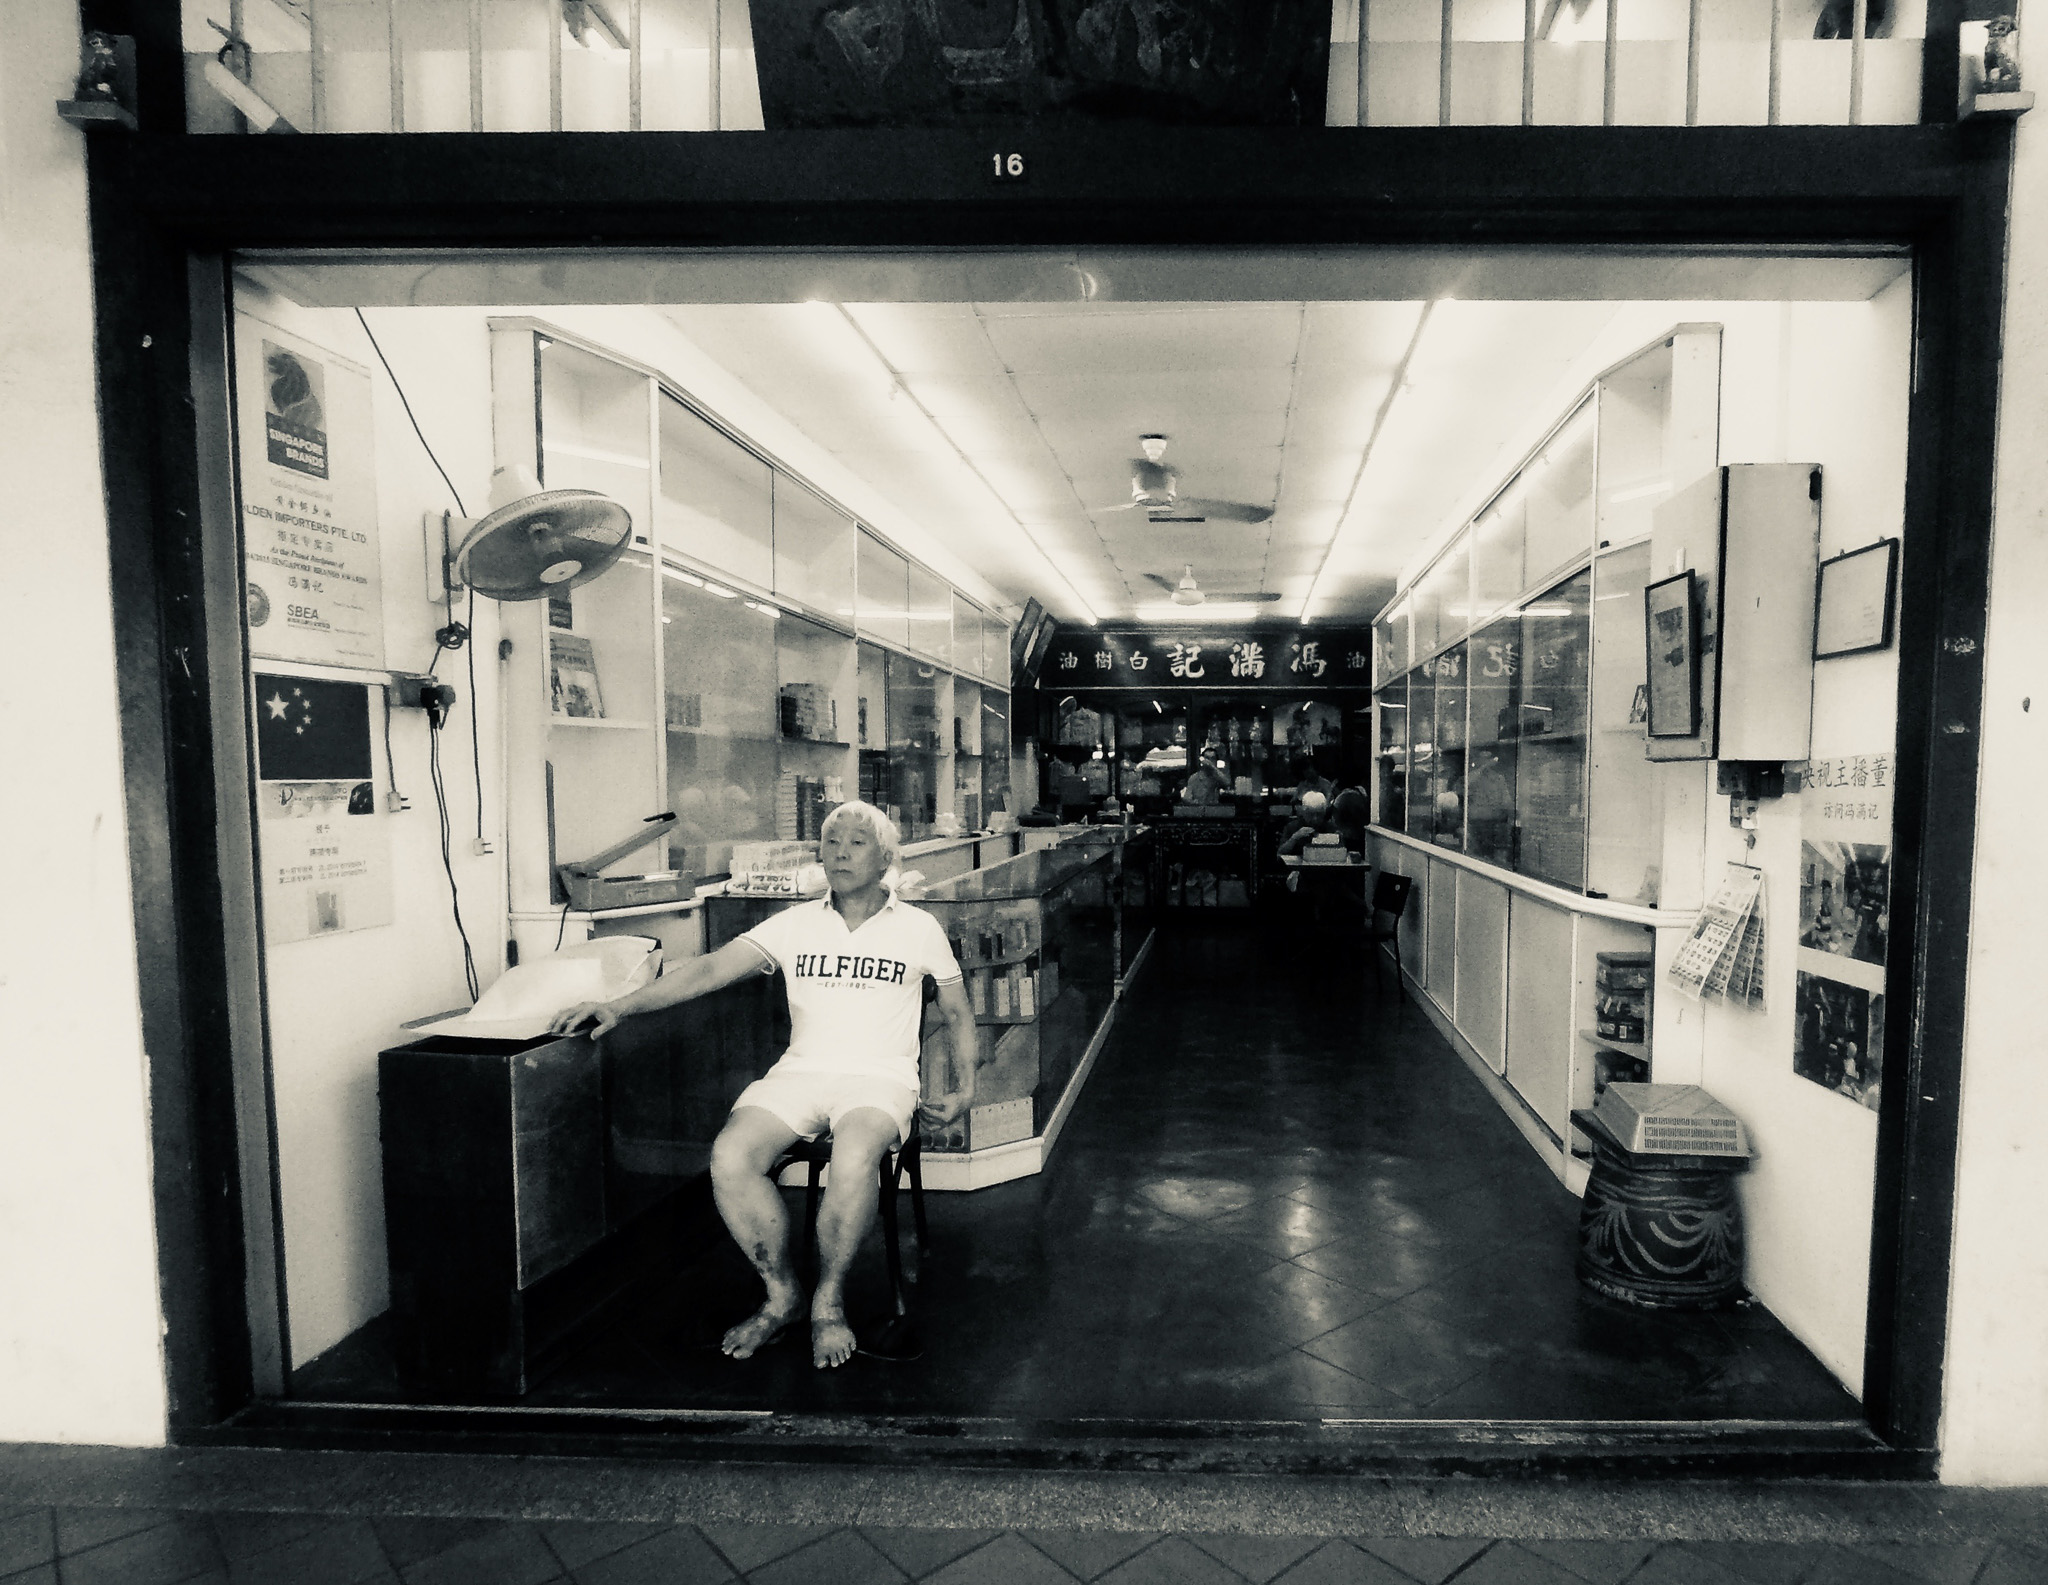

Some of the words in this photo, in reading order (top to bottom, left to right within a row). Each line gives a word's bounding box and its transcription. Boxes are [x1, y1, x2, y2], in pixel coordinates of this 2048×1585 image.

[992, 153, 1024, 177] 16
[269, 428, 324, 456] SINGAPORE
[285, 447, 325, 469] BRANDS
[243, 504, 273, 519] LDEN
[275, 511, 329, 535] IMPORTERS
[287, 604, 319, 620] SBEA
[1802, 756, 1894, 789] 央视主播董
[795, 954, 907, 985] HILFIGER
